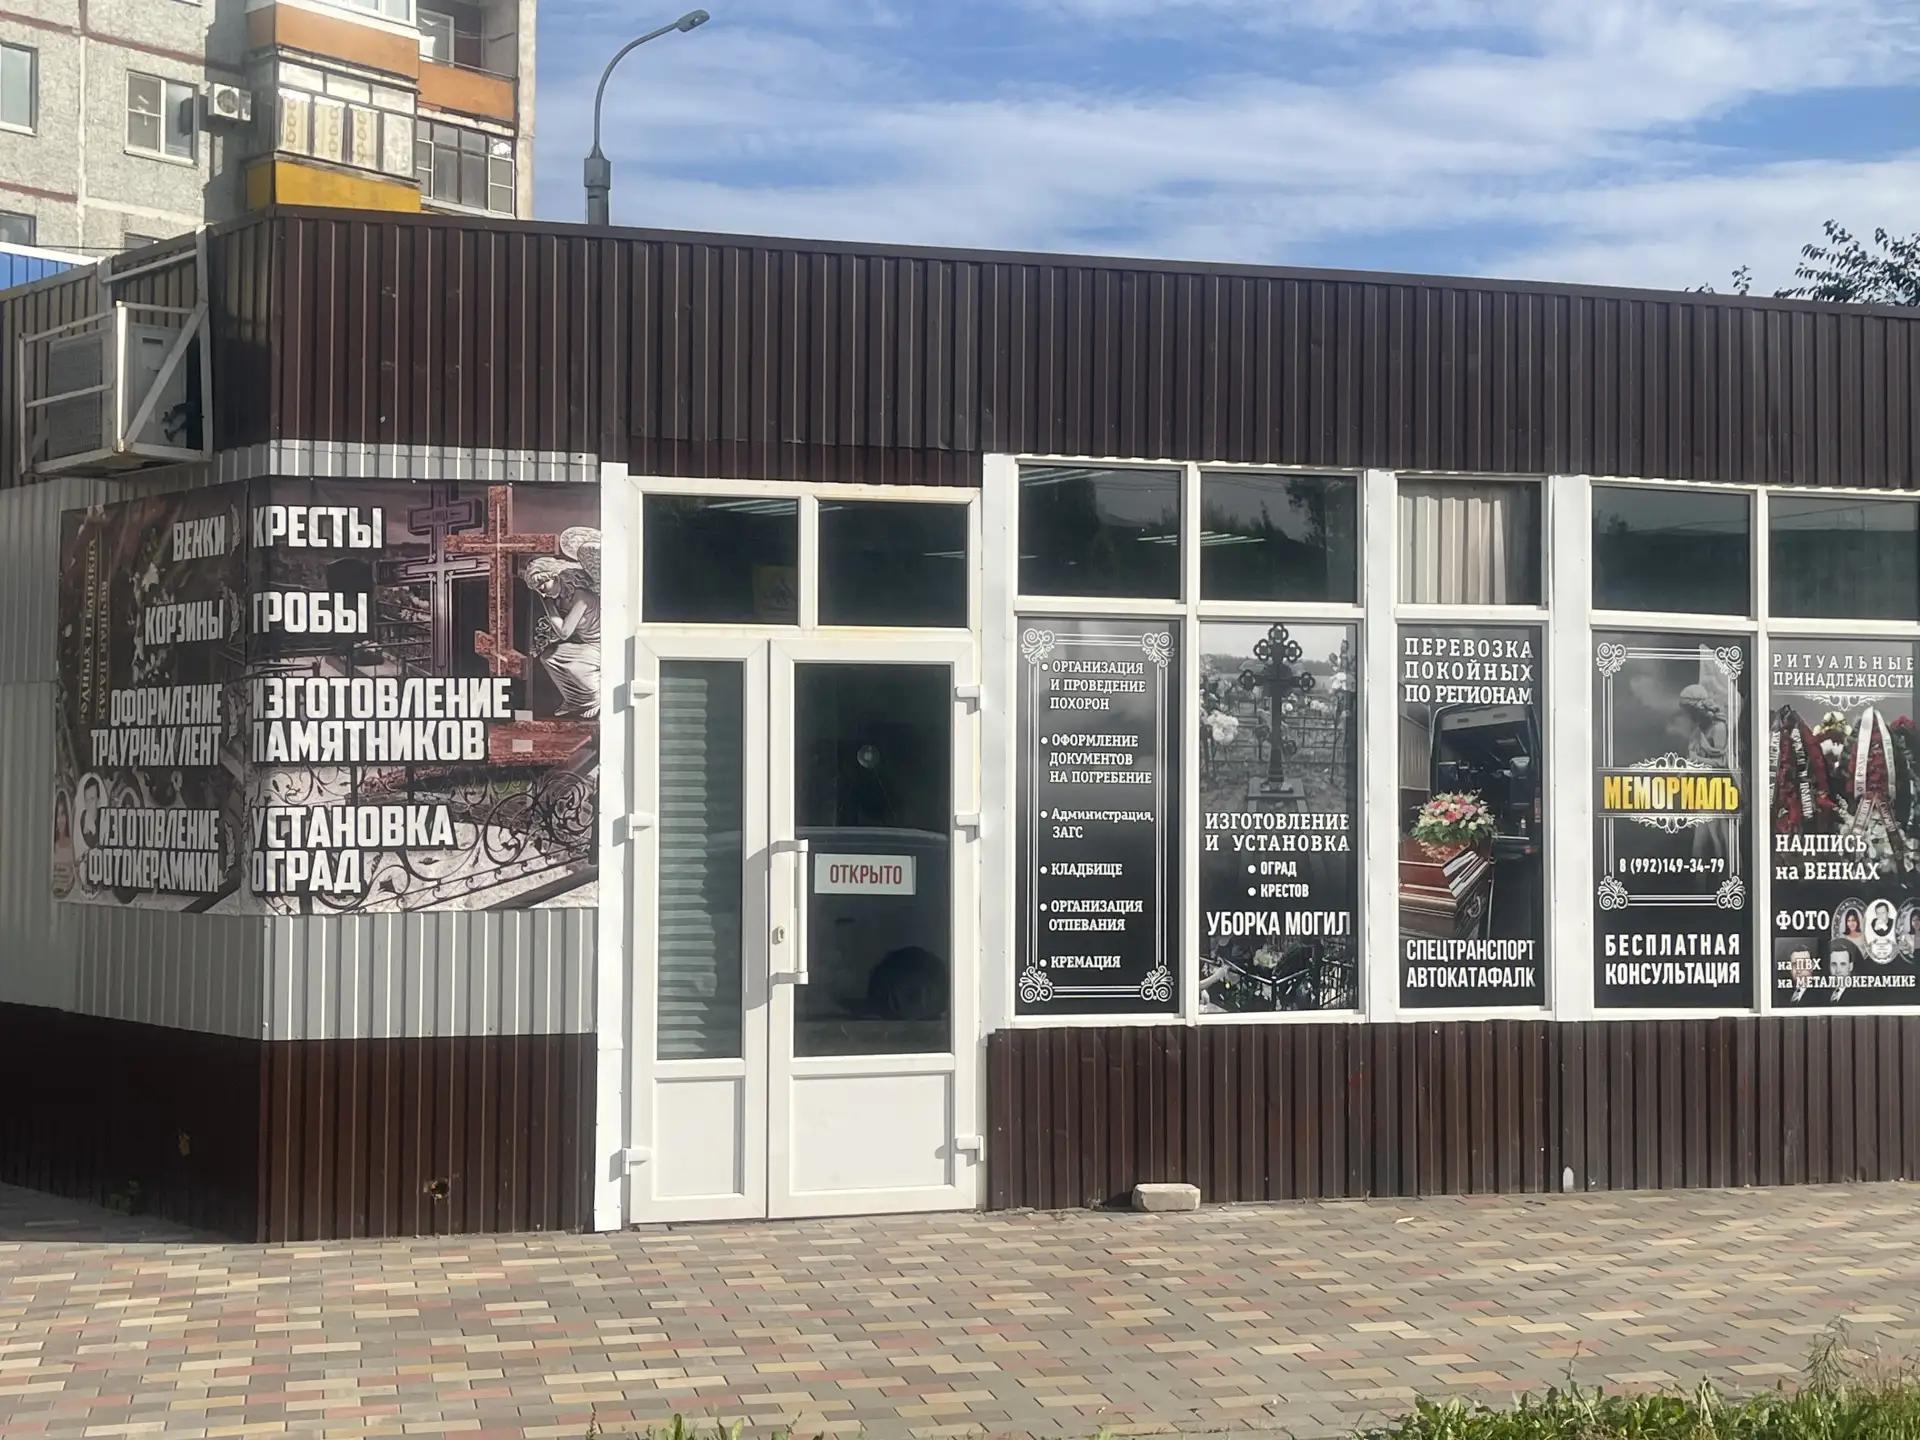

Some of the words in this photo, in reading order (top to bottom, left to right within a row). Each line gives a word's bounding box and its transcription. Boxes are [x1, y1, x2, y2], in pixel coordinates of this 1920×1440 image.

[252, 506, 382, 548] КРЕСТЫ
[172, 514, 226, 562] ВЕНКИ
[144, 599, 224, 646] КОРЗИНЫ
[252, 592, 368, 634] ГРОБЫ
[1404, 637, 1533, 659] ПЕРЕВОЗКА
[1052, 660, 1144, 677] ОРГАНИЗАЦИЯ
[1404, 659, 1534, 682] ПОКОЙНЫХ
[1773, 654, 1914, 671] РИТУАЛЬНЫЕ
[1050, 679, 1060, 692] И
[1063, 679, 1146, 695] ПРОВЕДЕНИЕ
[1773, 672, 1914, 689] ПРИНАДЛЕЖНОСТИ
[252, 677, 511, 719] ИЗГОТОВЛЕНИЕ
[1050, 697, 1110, 710] ПОХОРОН
[1404, 685, 1431, 703] ПО
[1435, 685, 1532, 705] РЕГИОНАМ
[110, 684, 223, 727] ОФОРМЛЕНИЕ
[91, 728, 178, 767] ТРАУРНЫХ
[178, 725, 222, 766] ЛЕНТ
[252, 720, 485, 762] ПАМЯТНИКОВ
[1051, 734, 1138, 748] ОФОРМЛЕНИЕ
[1049, 752, 1133, 767] ДОКУМЕНТОВ
[1049, 771, 1068, 784] НА
[1071, 771, 1152, 785] ПОГРЕБЕНИЕ
[1604, 775, 1739, 811] МЕМОРИАЛЪ
[1051, 807, 1154, 824] Администрация,
[1205, 812, 1350, 830] ИЗГОТОВЛЕНИЕ
[99, 808, 219, 850] ИЗГОТОВЛЕНИЕ
[251, 805, 454, 848] УСТАНОВКА
[1052, 826, 1084, 839] ЗАГС
[1205, 835, 1219, 851] И
[1232, 834, 1351, 852] УСТАНОВКА
[1775, 834, 1867, 854] НАДПИСЬ
[88, 849, 219, 893] ФОТОКЕРАМИКИ
[251, 850, 361, 893] ОГРАД
[830, 864, 902, 885] ОТКРЫТО
[1051, 863, 1123, 878] КЛАДБИЩЕ
[1260, 861, 1297, 878] ОГРАД
[1619, 859, 1627, 873] 8
[1775, 866, 1799, 880] на
[1804, 862, 1880, 881] ВЕНКАХ
[1260, 883, 1310, 898] КРЕСТОВ
[1050, 900, 1143, 915] ОРГАНИЗАЦИЯ
[1048, 918, 1126, 931] ОТПЕВАНИЯ
[1206, 911, 1281, 936] УБОРКА
[1285, 911, 1351, 936] МОГИЛ
[1776, 910, 1830, 930] ФОТО
[1406, 940, 1535, 962] СПЕЦТРАНСПОРТ
[1605, 934, 1740, 956] БЕСПЛАТНАЯ
[1050, 956, 1122, 970] КРЕМАЦИЯ
[1777, 960, 1792, 971] на
[1796, 958, 1821, 971] ПВХ
[1406, 966, 1536, 988] АВТОКАТАФАЛК
[1605, 962, 1740, 986] КОНСУЛЬТАЦИЯ
[1777, 977, 1792, 988] на
[1796, 975, 1916, 989] МЕТАЛЛОКЕРАМИКЕ
